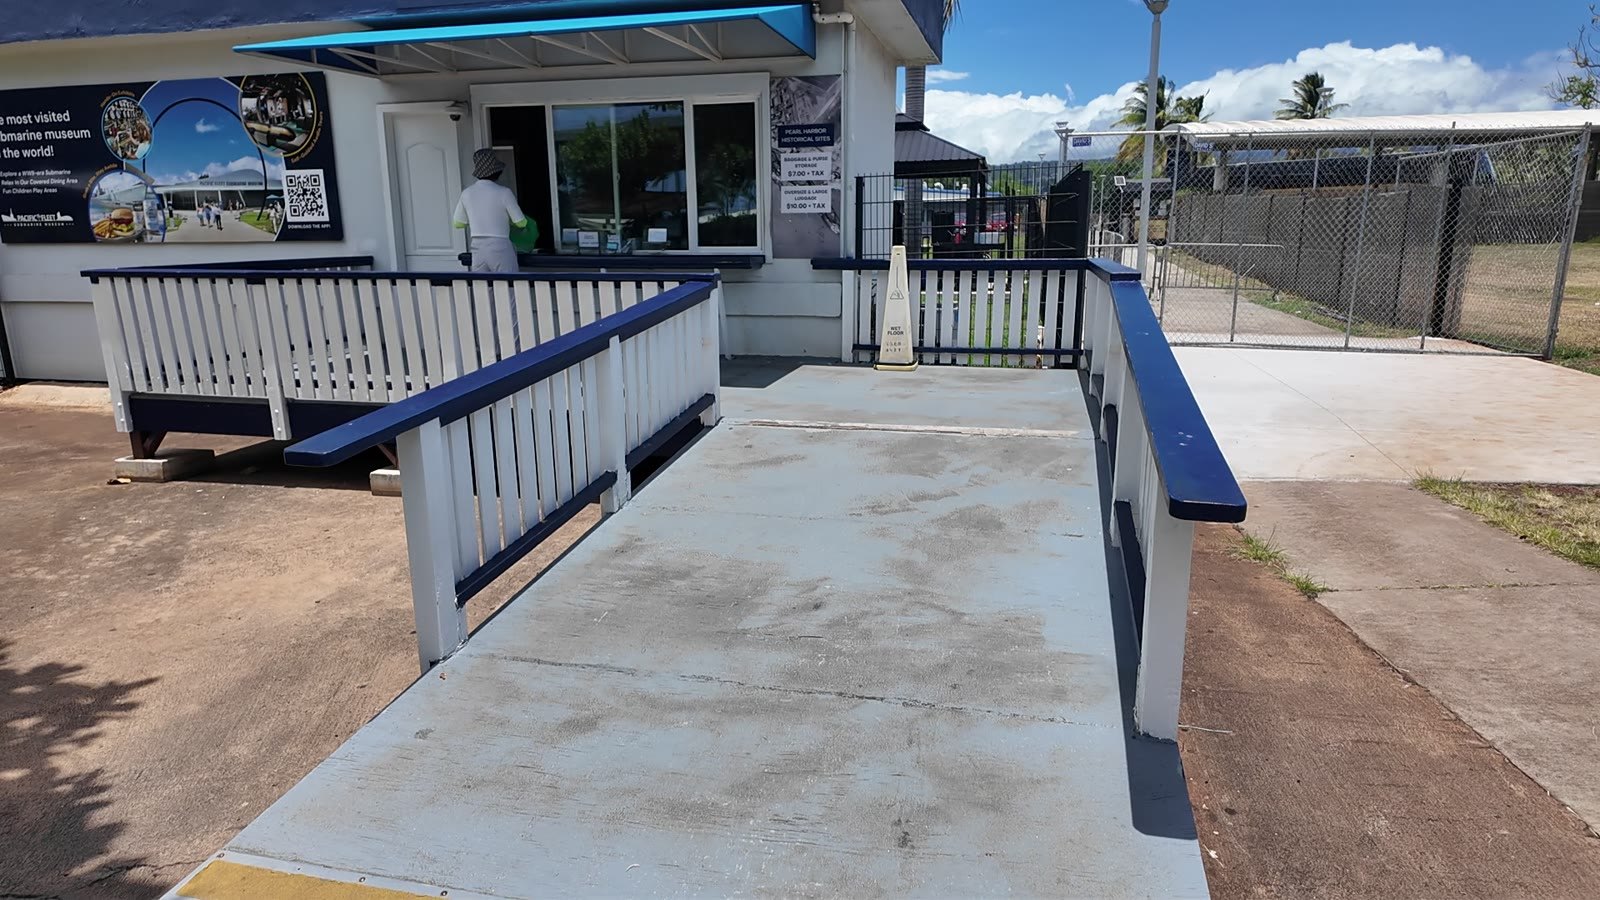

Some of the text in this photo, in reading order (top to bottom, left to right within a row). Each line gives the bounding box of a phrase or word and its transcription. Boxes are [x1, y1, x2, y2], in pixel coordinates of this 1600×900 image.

[6, 113, 33, 125] most
[34, 110, 71, 123] visited
[44, 129, 91, 140] museum
[2, 147, 20, 159] the
[22, 145, 54, 158] world!
[50, 178, 66, 186] Dining
